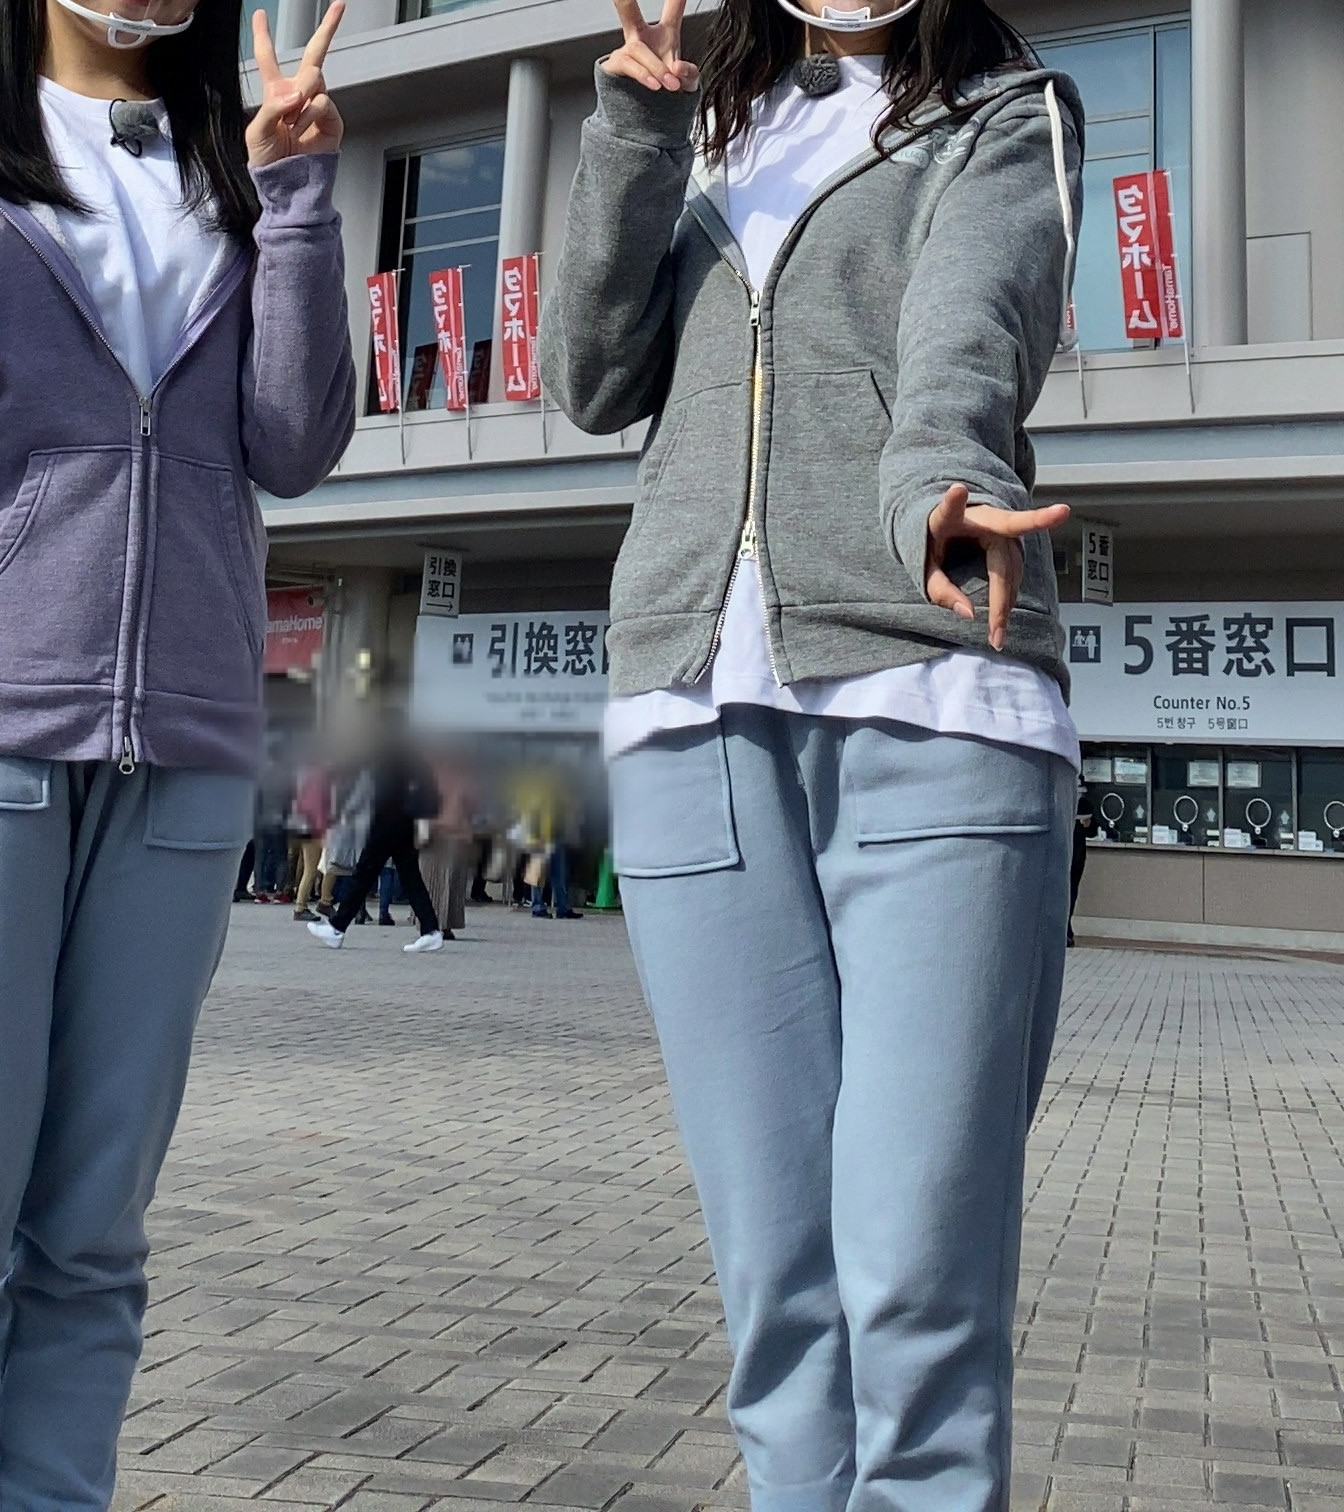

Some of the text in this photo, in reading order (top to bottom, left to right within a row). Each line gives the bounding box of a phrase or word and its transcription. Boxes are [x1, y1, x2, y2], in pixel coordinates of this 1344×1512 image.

[429, 557, 457, 577] 引換
[427, 580, 455, 599] 窓口
[488, 621, 611, 677] 引換窓
[1123, 612, 1336, 678] 5番窓口
[1153, 695, 1251, 711] Counter No.5
